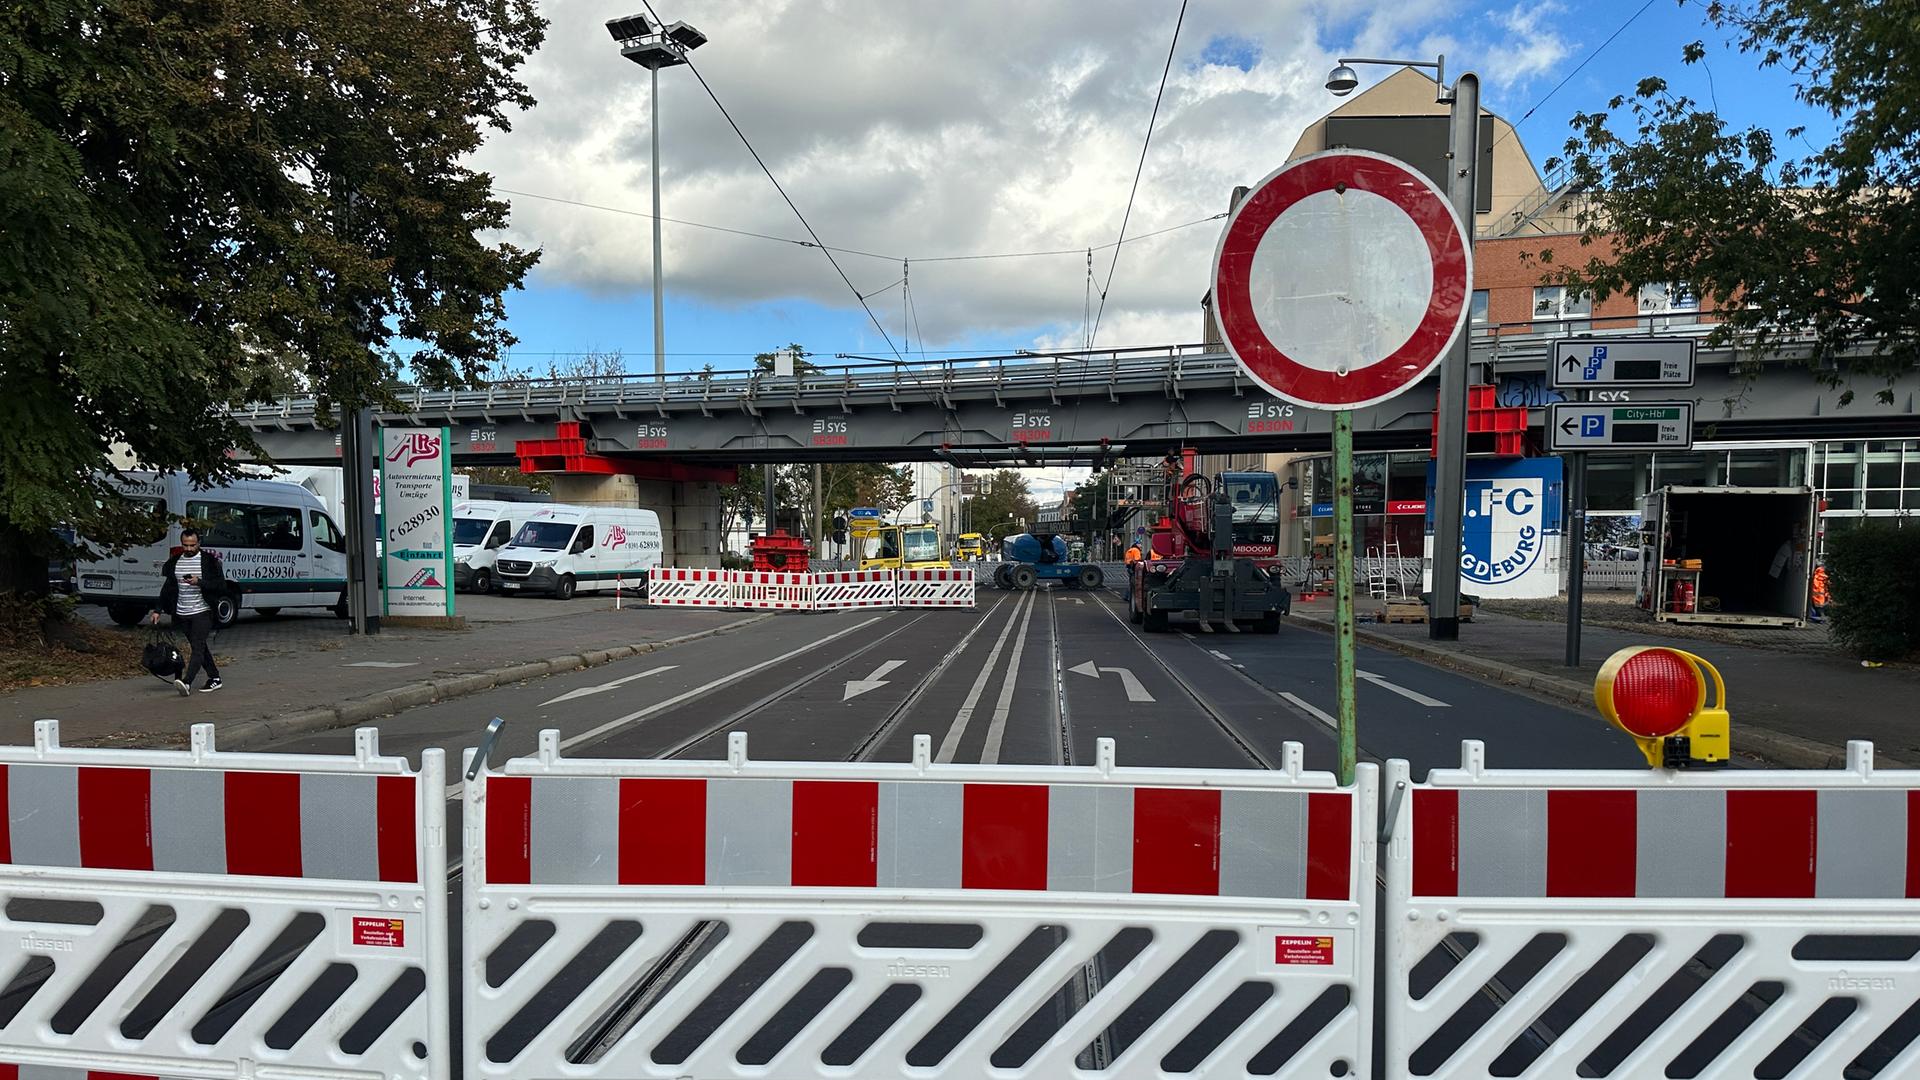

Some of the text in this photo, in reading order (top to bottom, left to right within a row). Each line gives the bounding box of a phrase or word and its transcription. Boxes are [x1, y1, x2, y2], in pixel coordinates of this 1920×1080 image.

[1663, 370, 1681, 378] Plätze
[1268, 405, 1294, 417] SYS
[1627, 410, 1666, 419] City-Hbf
[1029, 416, 1051, 426] SYS
[650, 427, 667, 437] SYS
[828, 423, 847, 432] SYS
[1661, 425, 1675, 433] freie
[481, 432, 497, 441] SYS
[1661, 433, 1679, 441] Plätze
[386, 474, 442, 482] Autovermietung
[117, 484, 165, 496] 628930
[395, 482, 432, 491] Transporte
[400, 491, 428, 499] Umzüge
[398, 505, 440, 536] 628930
[1262, 535, 1274, 543] 757
[224, 551, 297, 566] Autovermietung
[400, 551, 444, 559] Einfahrt
[20, 931, 73, 951] nissen
[886, 957, 951, 978] nissen
[1827, 969, 1896, 990] nissen
